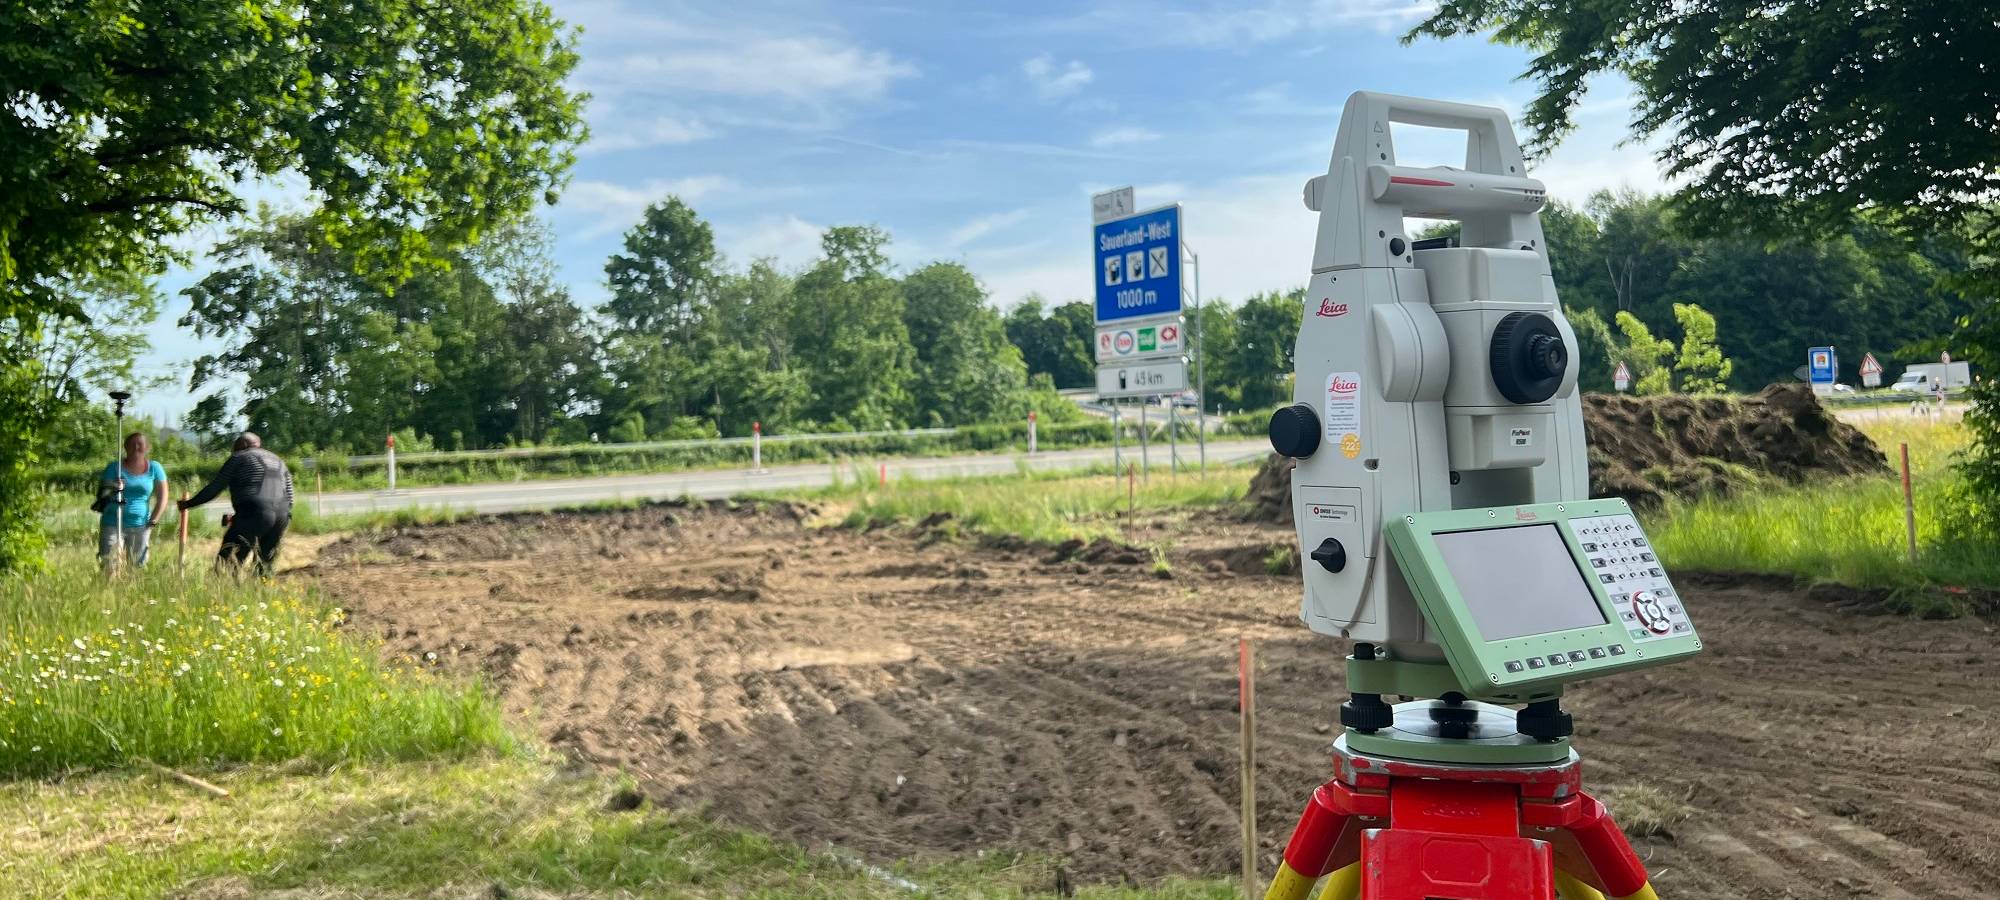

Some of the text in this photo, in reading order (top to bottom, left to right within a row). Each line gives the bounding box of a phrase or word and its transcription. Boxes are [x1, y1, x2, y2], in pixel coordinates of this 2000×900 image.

[1100, 221, 1171, 251] Sauerland-West
[1116, 288, 1157, 309] 1000 m
[1316, 297, 1349, 317] Leica
[1148, 370, 1163, 385] km
[1328, 375, 1357, 393] Leica
[1345, 442, 1356, 450] 22
